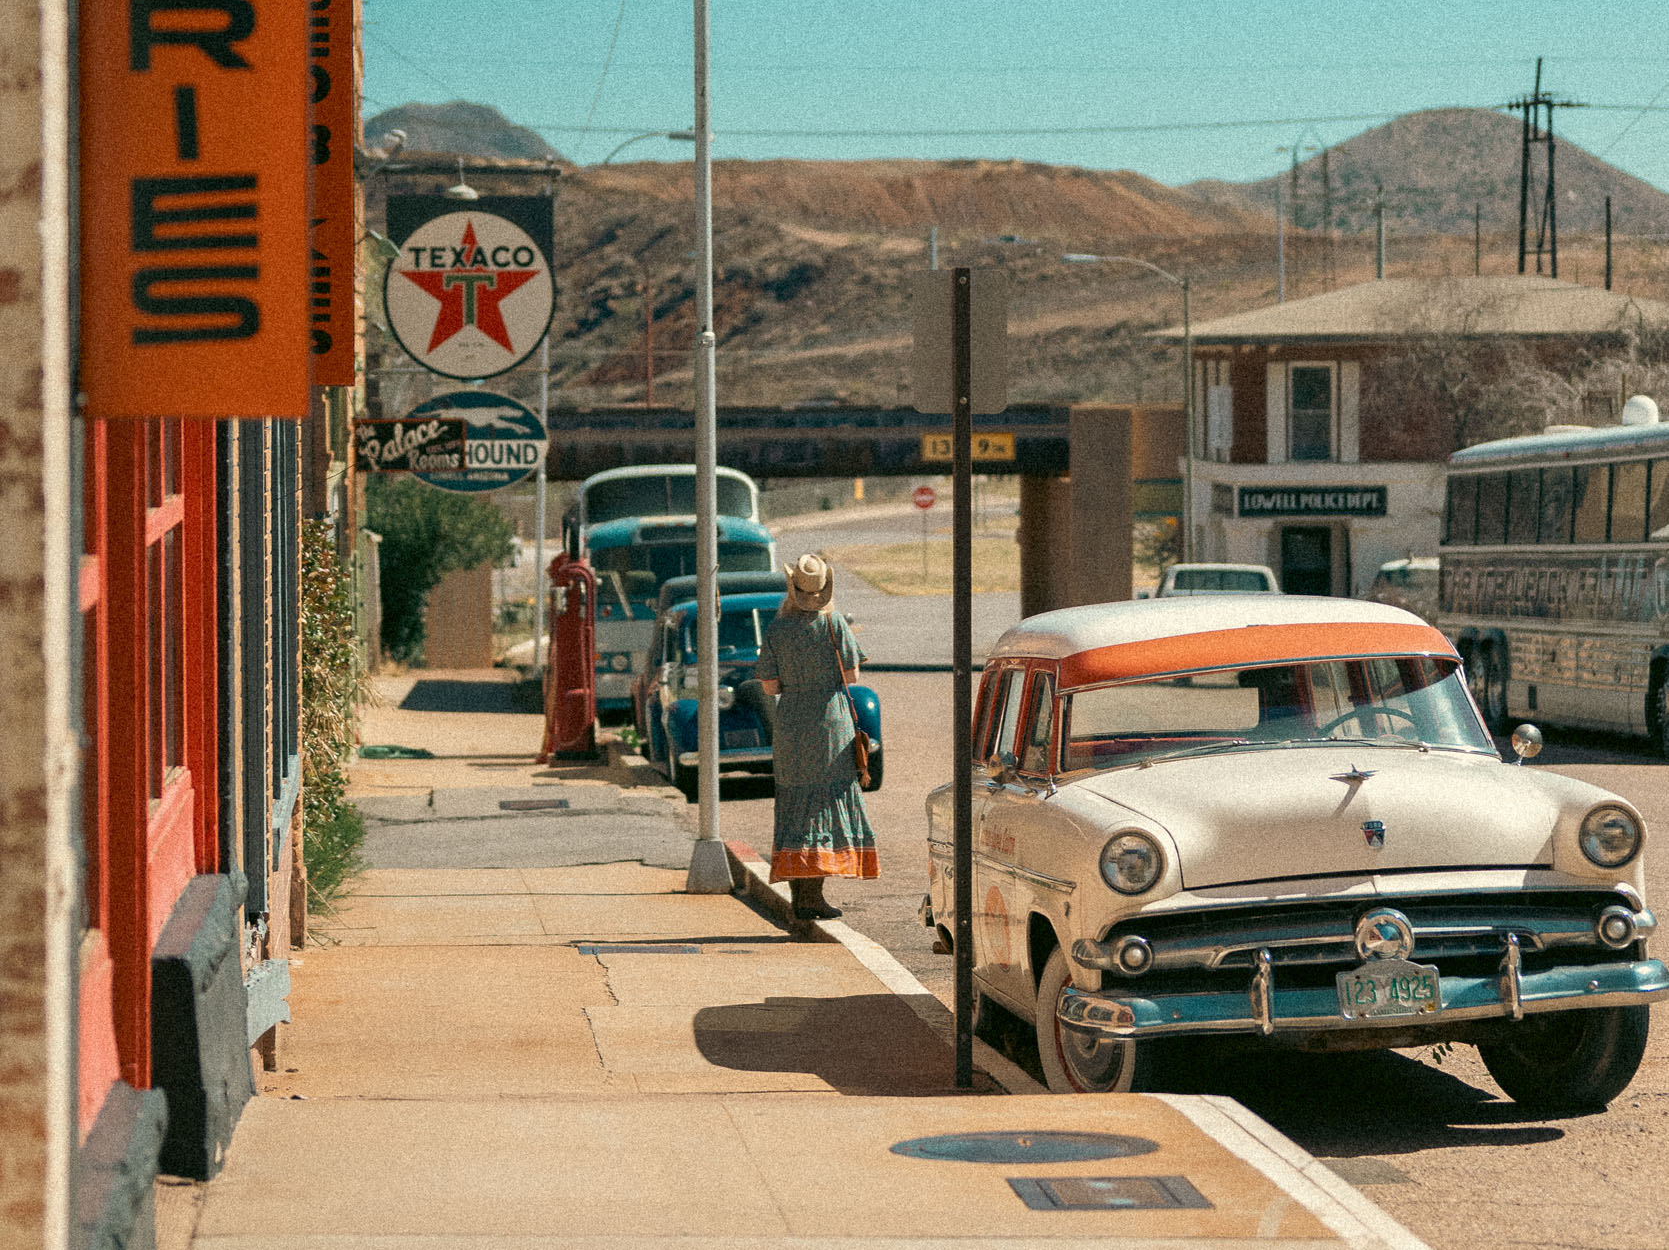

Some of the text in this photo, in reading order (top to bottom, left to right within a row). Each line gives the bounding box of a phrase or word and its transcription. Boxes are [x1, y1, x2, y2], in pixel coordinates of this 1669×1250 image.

[409, 245, 534, 268] TEXACO
[358, 420, 450, 472] Palace
[1243, 493, 1296, 509] LOWELL
[1300, 493, 1345, 509] POLICE
[1345, 975, 1434, 1005] 123 4925
